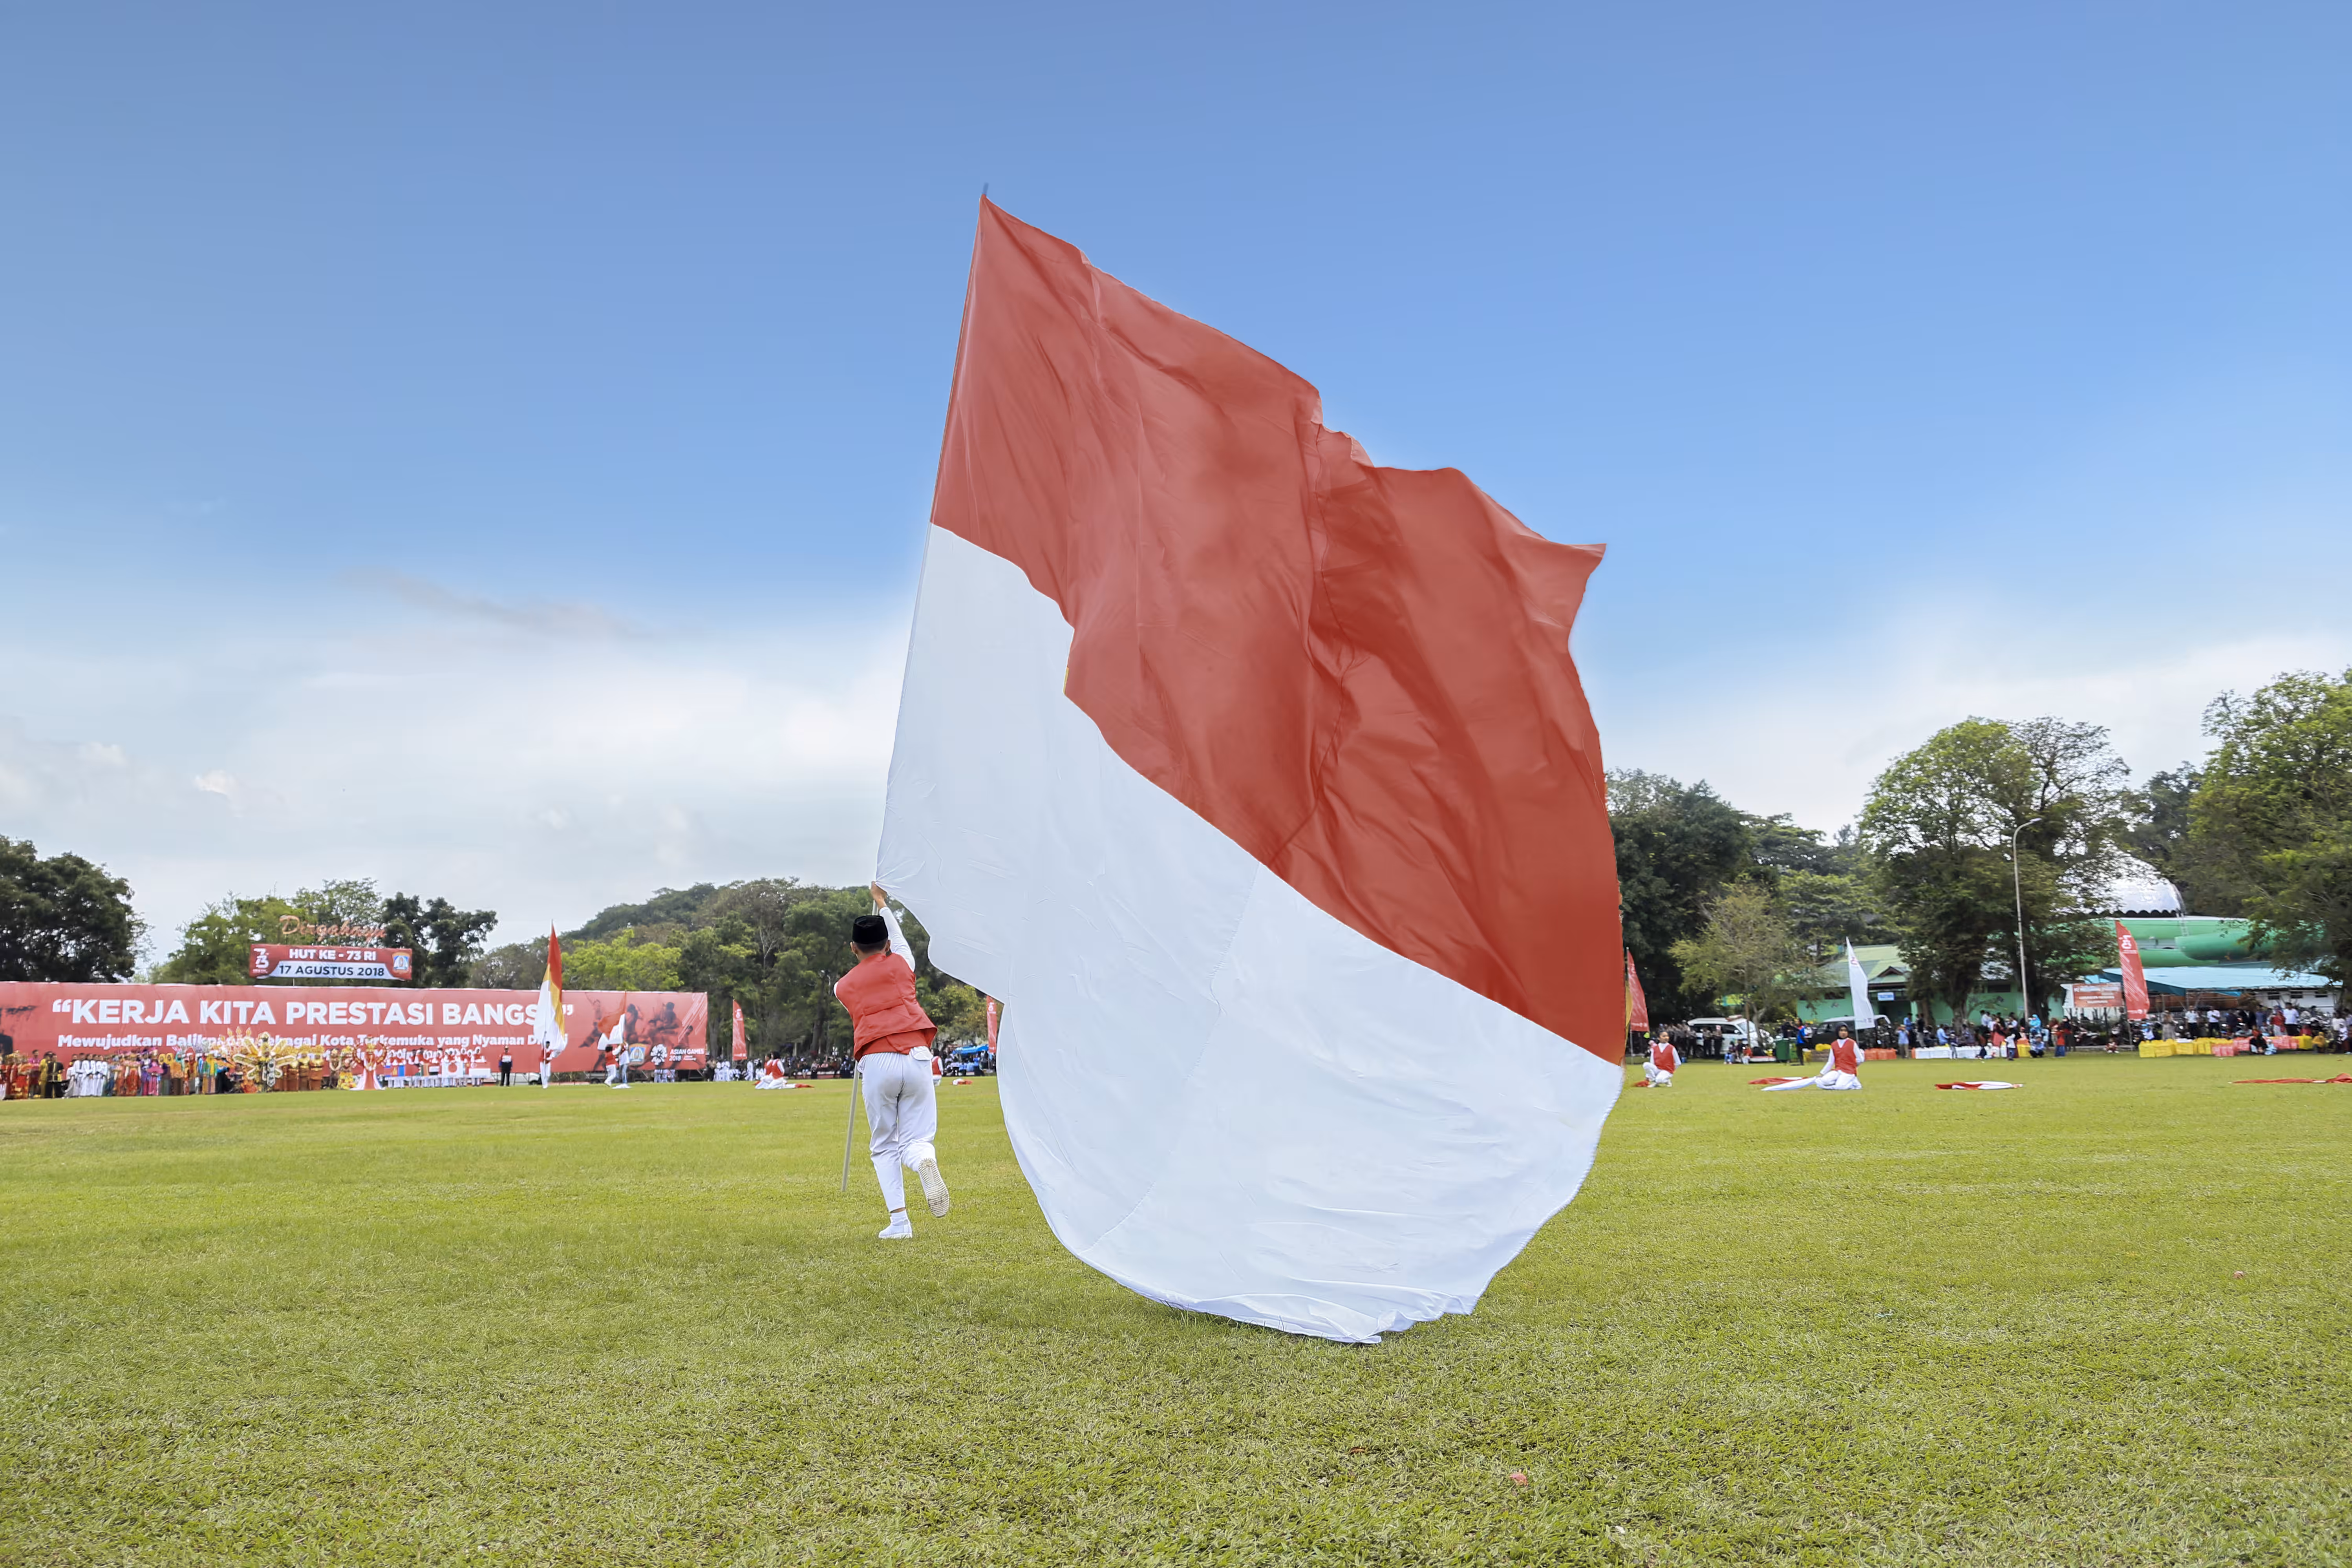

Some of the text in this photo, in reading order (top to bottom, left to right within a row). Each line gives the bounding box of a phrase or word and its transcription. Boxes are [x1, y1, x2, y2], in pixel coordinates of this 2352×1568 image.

[289, 948, 316, 959] HUT
[319, 949, 336, 960] KE
[347, 950, 361, 961] 73
[364, 951, 376, 961] RI
[279, 965, 384, 976] 17 AGUSTUS 2018
[52, 999, 190, 1024] “KERJA
[199, 1000, 276, 1024] KITA
[286, 1002, 433, 1025] PRESTASI
[58, 1033, 162, 1050] Mewujudkan
[320, 1034, 354, 1046] Kota
[437, 1036, 470, 1047] yang
[472, 1034, 525, 1048] Nyaman
